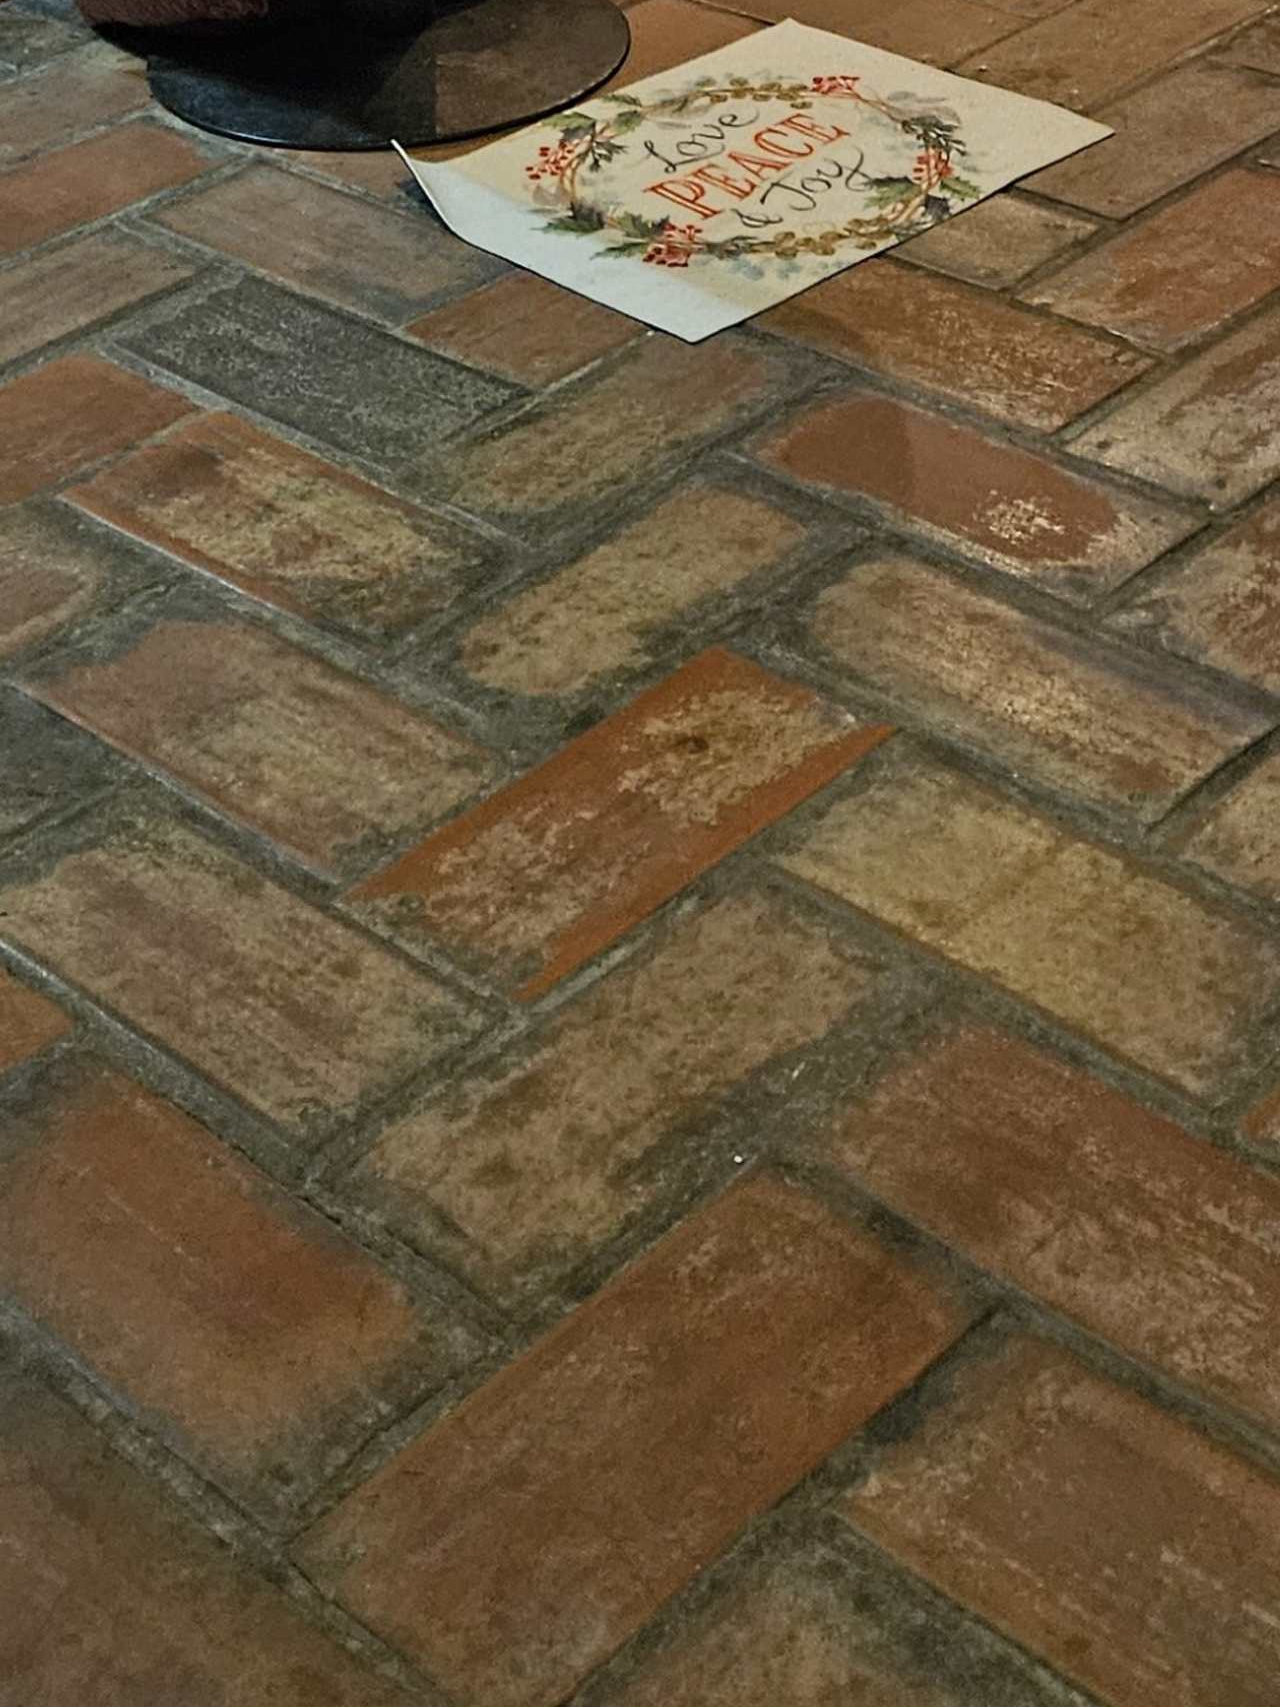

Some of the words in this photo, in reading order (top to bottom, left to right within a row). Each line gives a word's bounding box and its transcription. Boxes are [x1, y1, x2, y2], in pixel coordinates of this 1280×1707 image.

[643, 112, 852, 220] PEACE
[644, 108, 761, 174] Love
[759, 146, 876, 212] Joy
